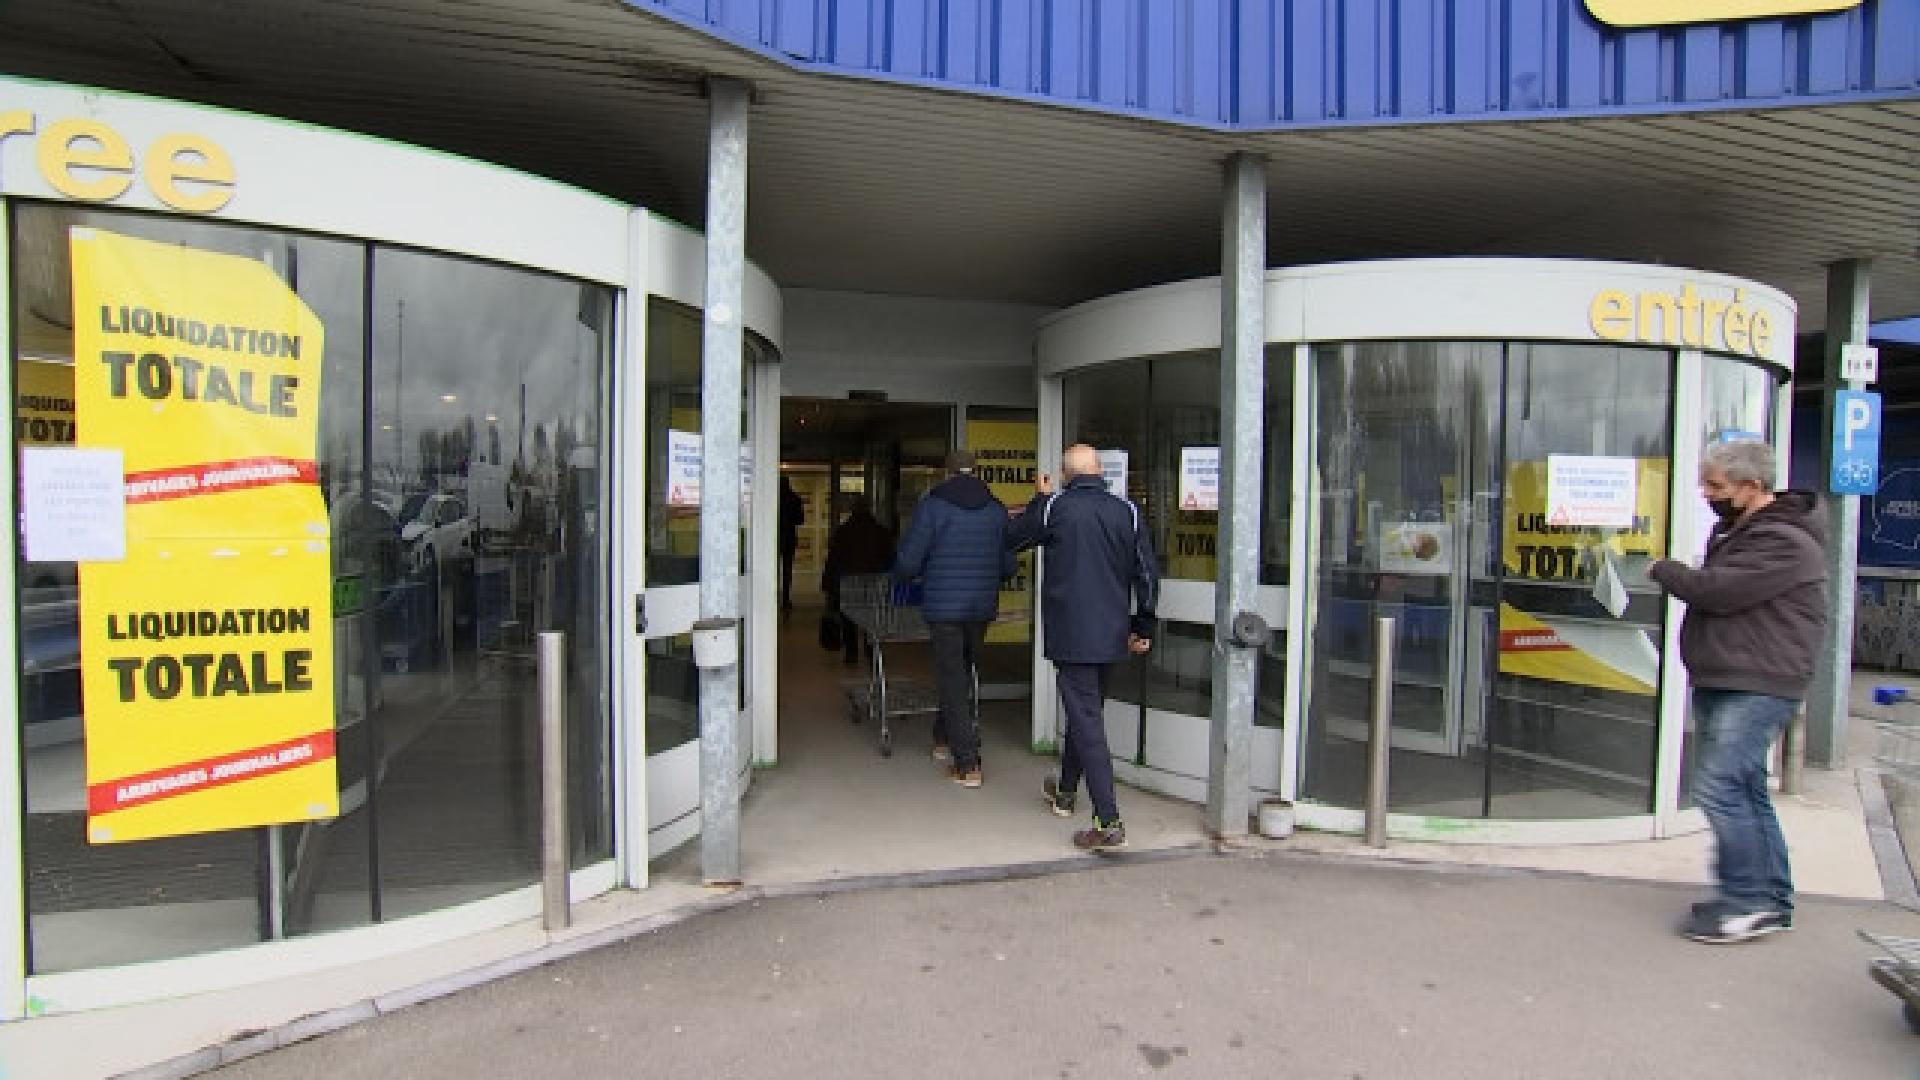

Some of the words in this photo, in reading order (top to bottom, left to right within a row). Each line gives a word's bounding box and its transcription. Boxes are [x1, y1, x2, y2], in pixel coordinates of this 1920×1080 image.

[101, 304, 302, 360] LIQUIDATION
[1590, 281, 1773, 357] entrée
[101, 351, 300, 418] TOTALE
[1845, 399, 1871, 451] P
[107, 608, 310, 642] LIQUIDATION
[108, 648, 313, 703] TOTALE
